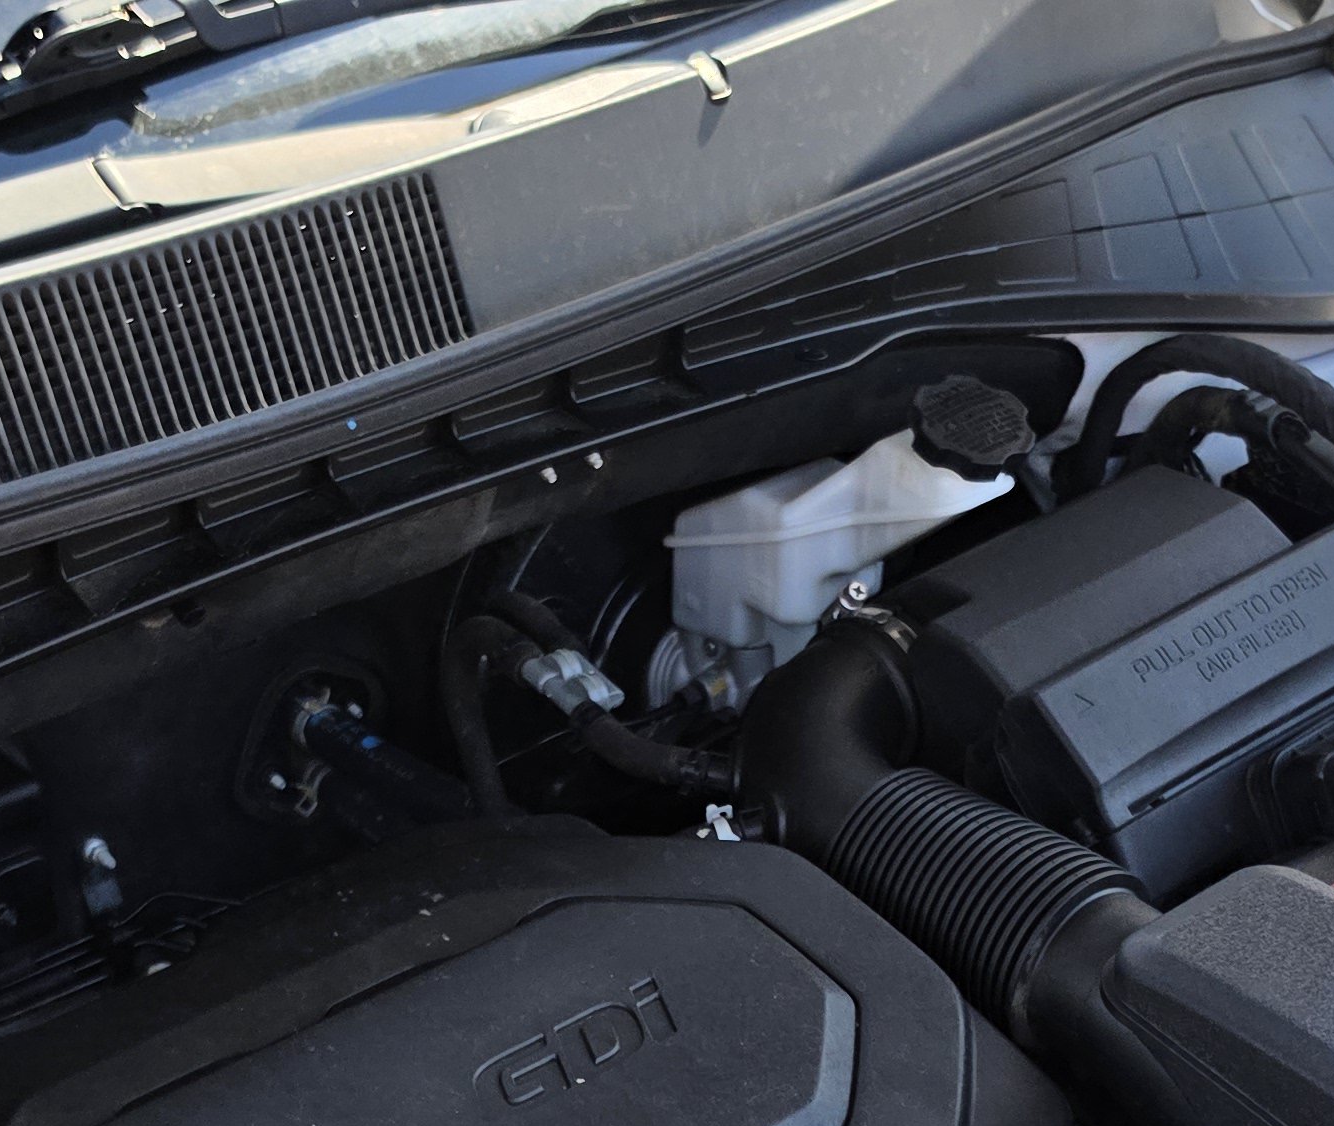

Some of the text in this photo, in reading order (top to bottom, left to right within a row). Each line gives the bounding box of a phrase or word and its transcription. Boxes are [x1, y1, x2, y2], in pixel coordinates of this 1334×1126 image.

[1130, 562, 1328, 684] PULL OUT TO OPEN
[1196, 609, 1307, 683] (AIR FILTER)
